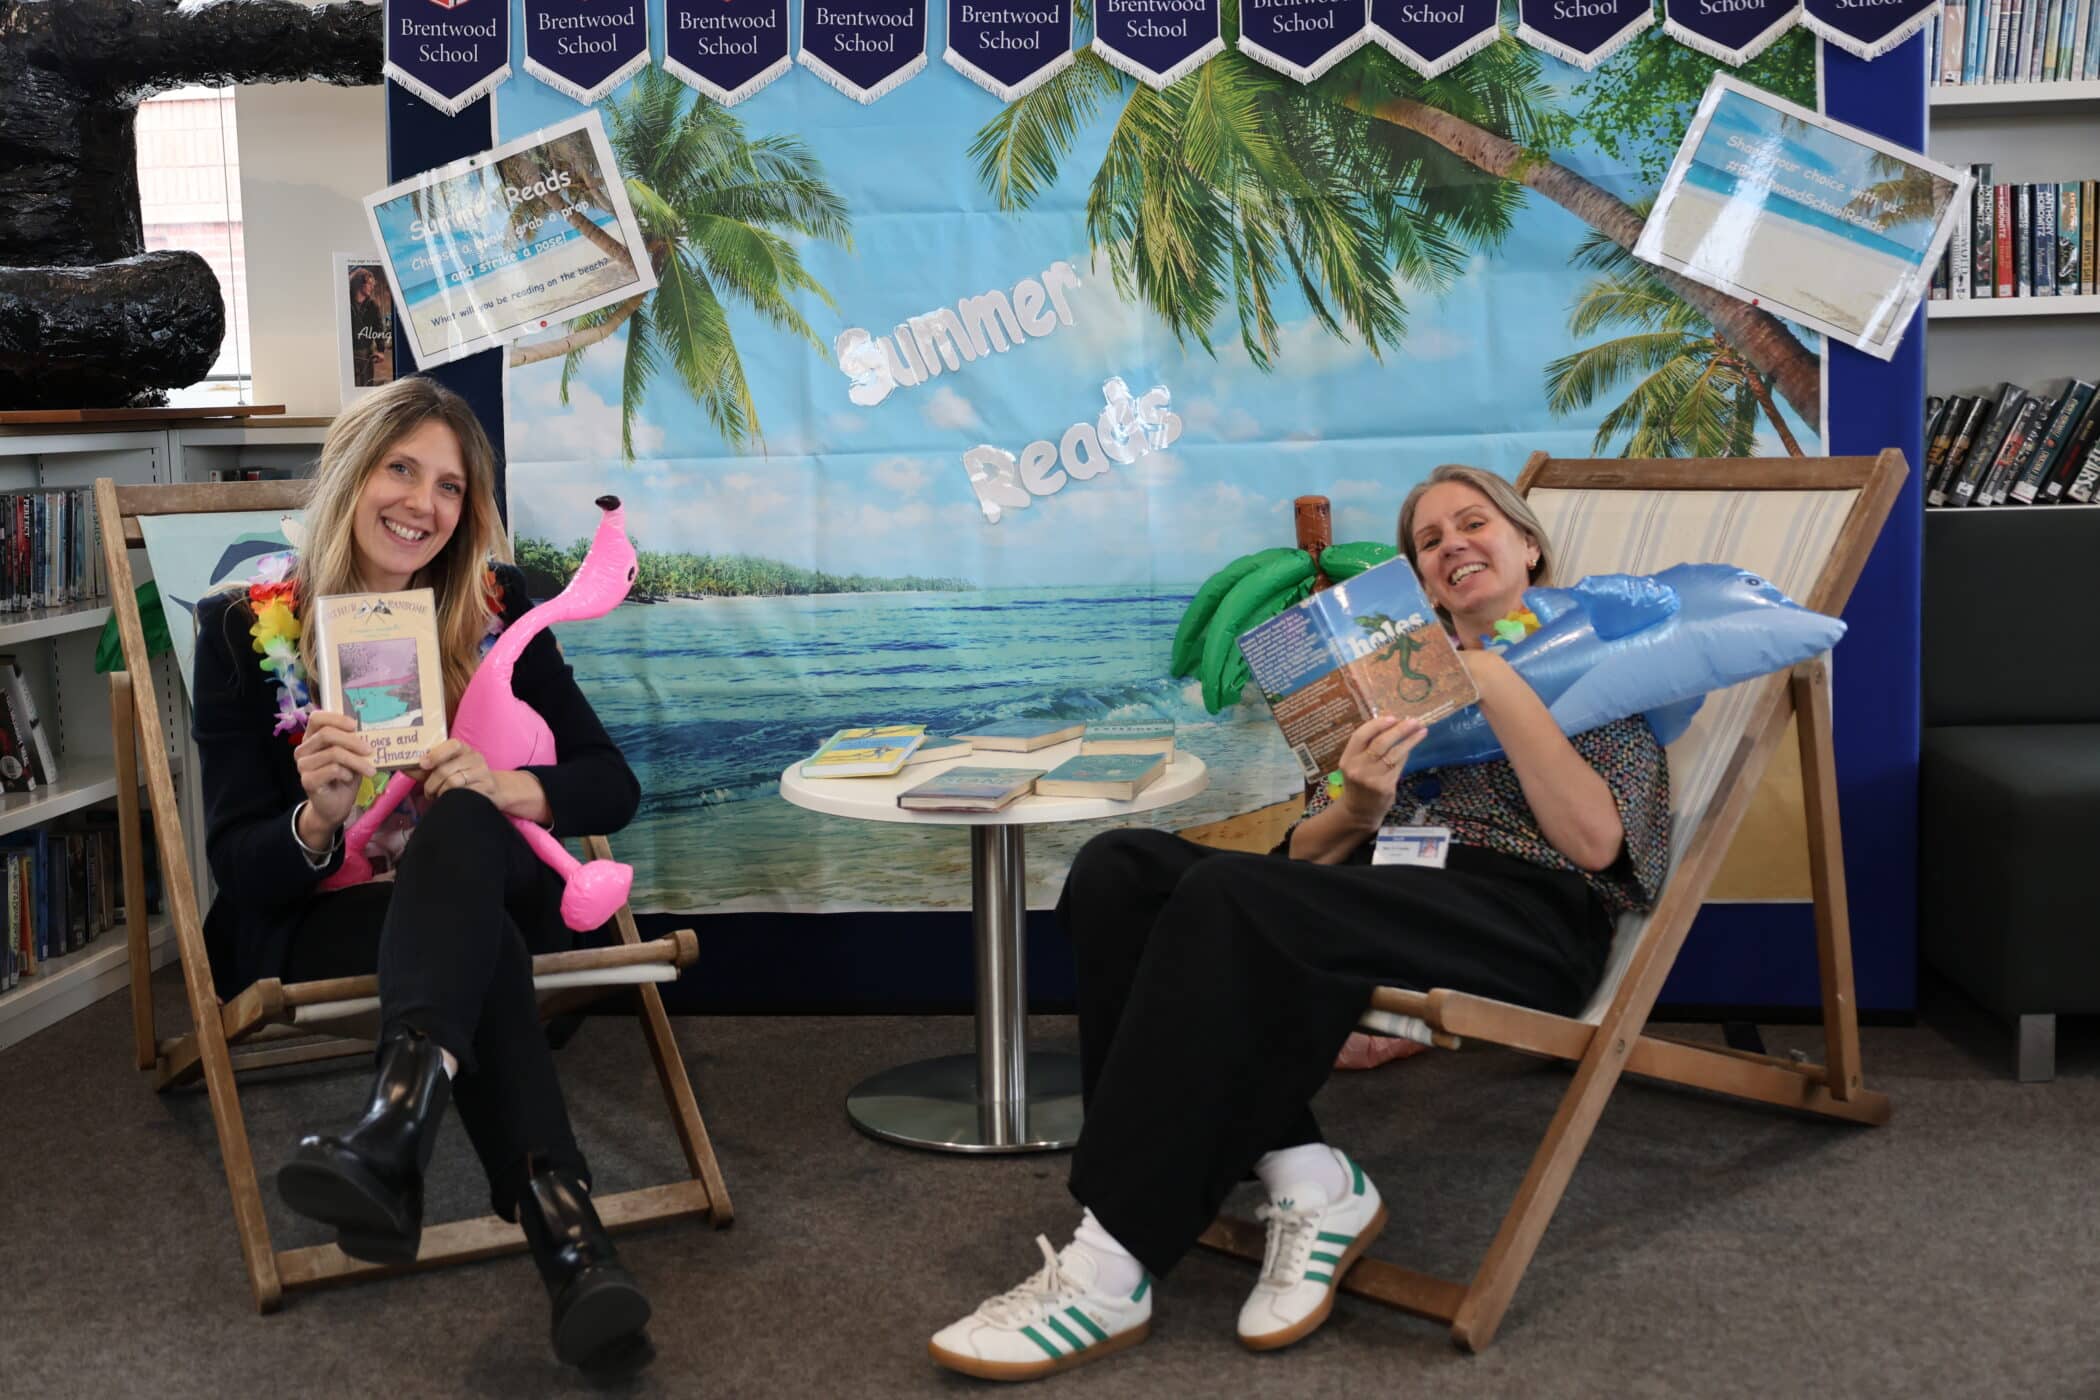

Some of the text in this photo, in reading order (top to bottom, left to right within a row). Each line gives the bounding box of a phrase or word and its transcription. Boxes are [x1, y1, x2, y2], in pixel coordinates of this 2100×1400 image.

[538, 6, 635, 31] Brentwood
[680, 9, 776, 29] Brentwood
[816, 7, 914, 27] Brentwood
[960, 5, 1060, 24] Brentwood
[1273, 10, 1335, 33] School
[1401, 5, 1465, 24] School
[1553, 0, 1618, 20] School
[400, 18, 497, 37] Brentwood
[1127, 19, 1188, 38] School
[557, 33, 618, 56] School
[698, 35, 758, 56] School
[833, 33, 895, 53] School
[979, 31, 1040, 50] School
[419, 44, 479, 63] School
[505, 168, 572, 209] Reads
[1803, 169, 1846, 193] choice
[1851, 187, 1879, 208] with
[1883, 200, 1905, 217] us:
[1984, 185, 1993, 226] ANTHONY
[2037, 191, 2046, 237] HOROWITZ
[2045, 191, 2056, 237] ANTHONY
[515, 216, 544, 239] grab
[549, 213, 558, 222] a
[561, 200, 589, 221] prop
[1998, 196, 2007, 239] HOROWITZ
[451, 231, 566, 283] and strike a pose!
[431, 256, 609, 328] What will you be reading on the beach?
[358, 325, 393, 344] Along
[834, 261, 1081, 407] Summer
[962, 376, 1183, 525] Reads
[396, 730, 419, 746] and
